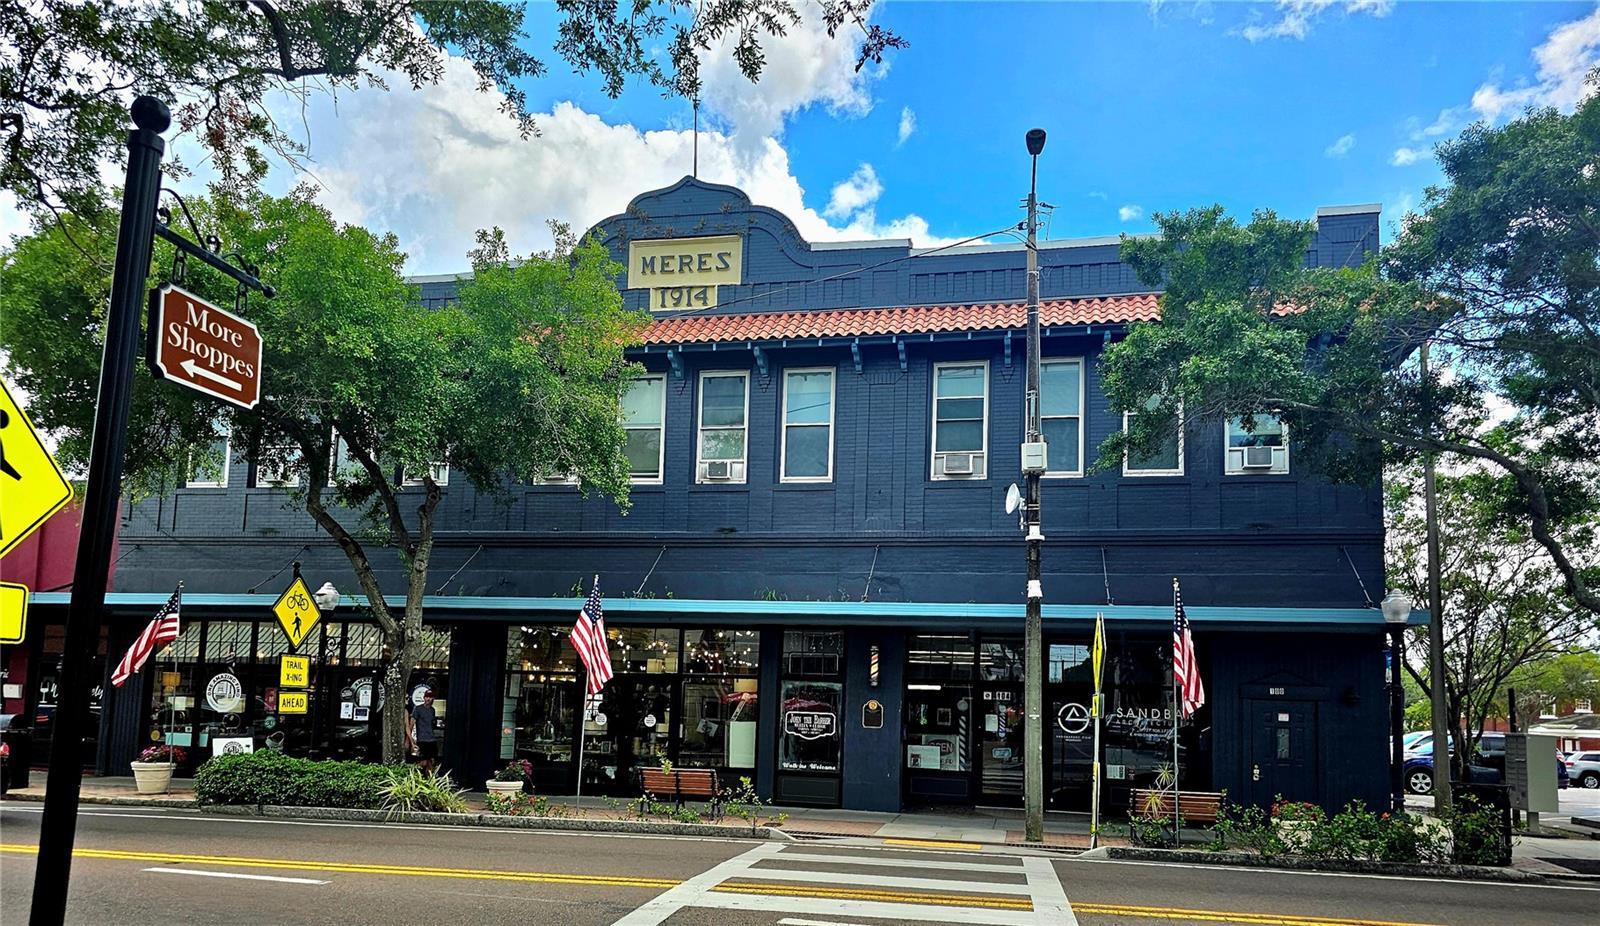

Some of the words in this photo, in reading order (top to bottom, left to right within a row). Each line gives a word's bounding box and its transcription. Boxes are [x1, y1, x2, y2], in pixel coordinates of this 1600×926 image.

[641, 251, 732, 275] MERES
[660, 287, 709, 308] 1914
[185, 301, 243, 348] More
[167, 322, 254, 379] Shoppes
[286, 661, 303, 670] TRAIL
[212, 674, 237, 684] AMAZING
[286, 673, 302, 682] X-ING
[281, 698, 304, 708] AHEAD
